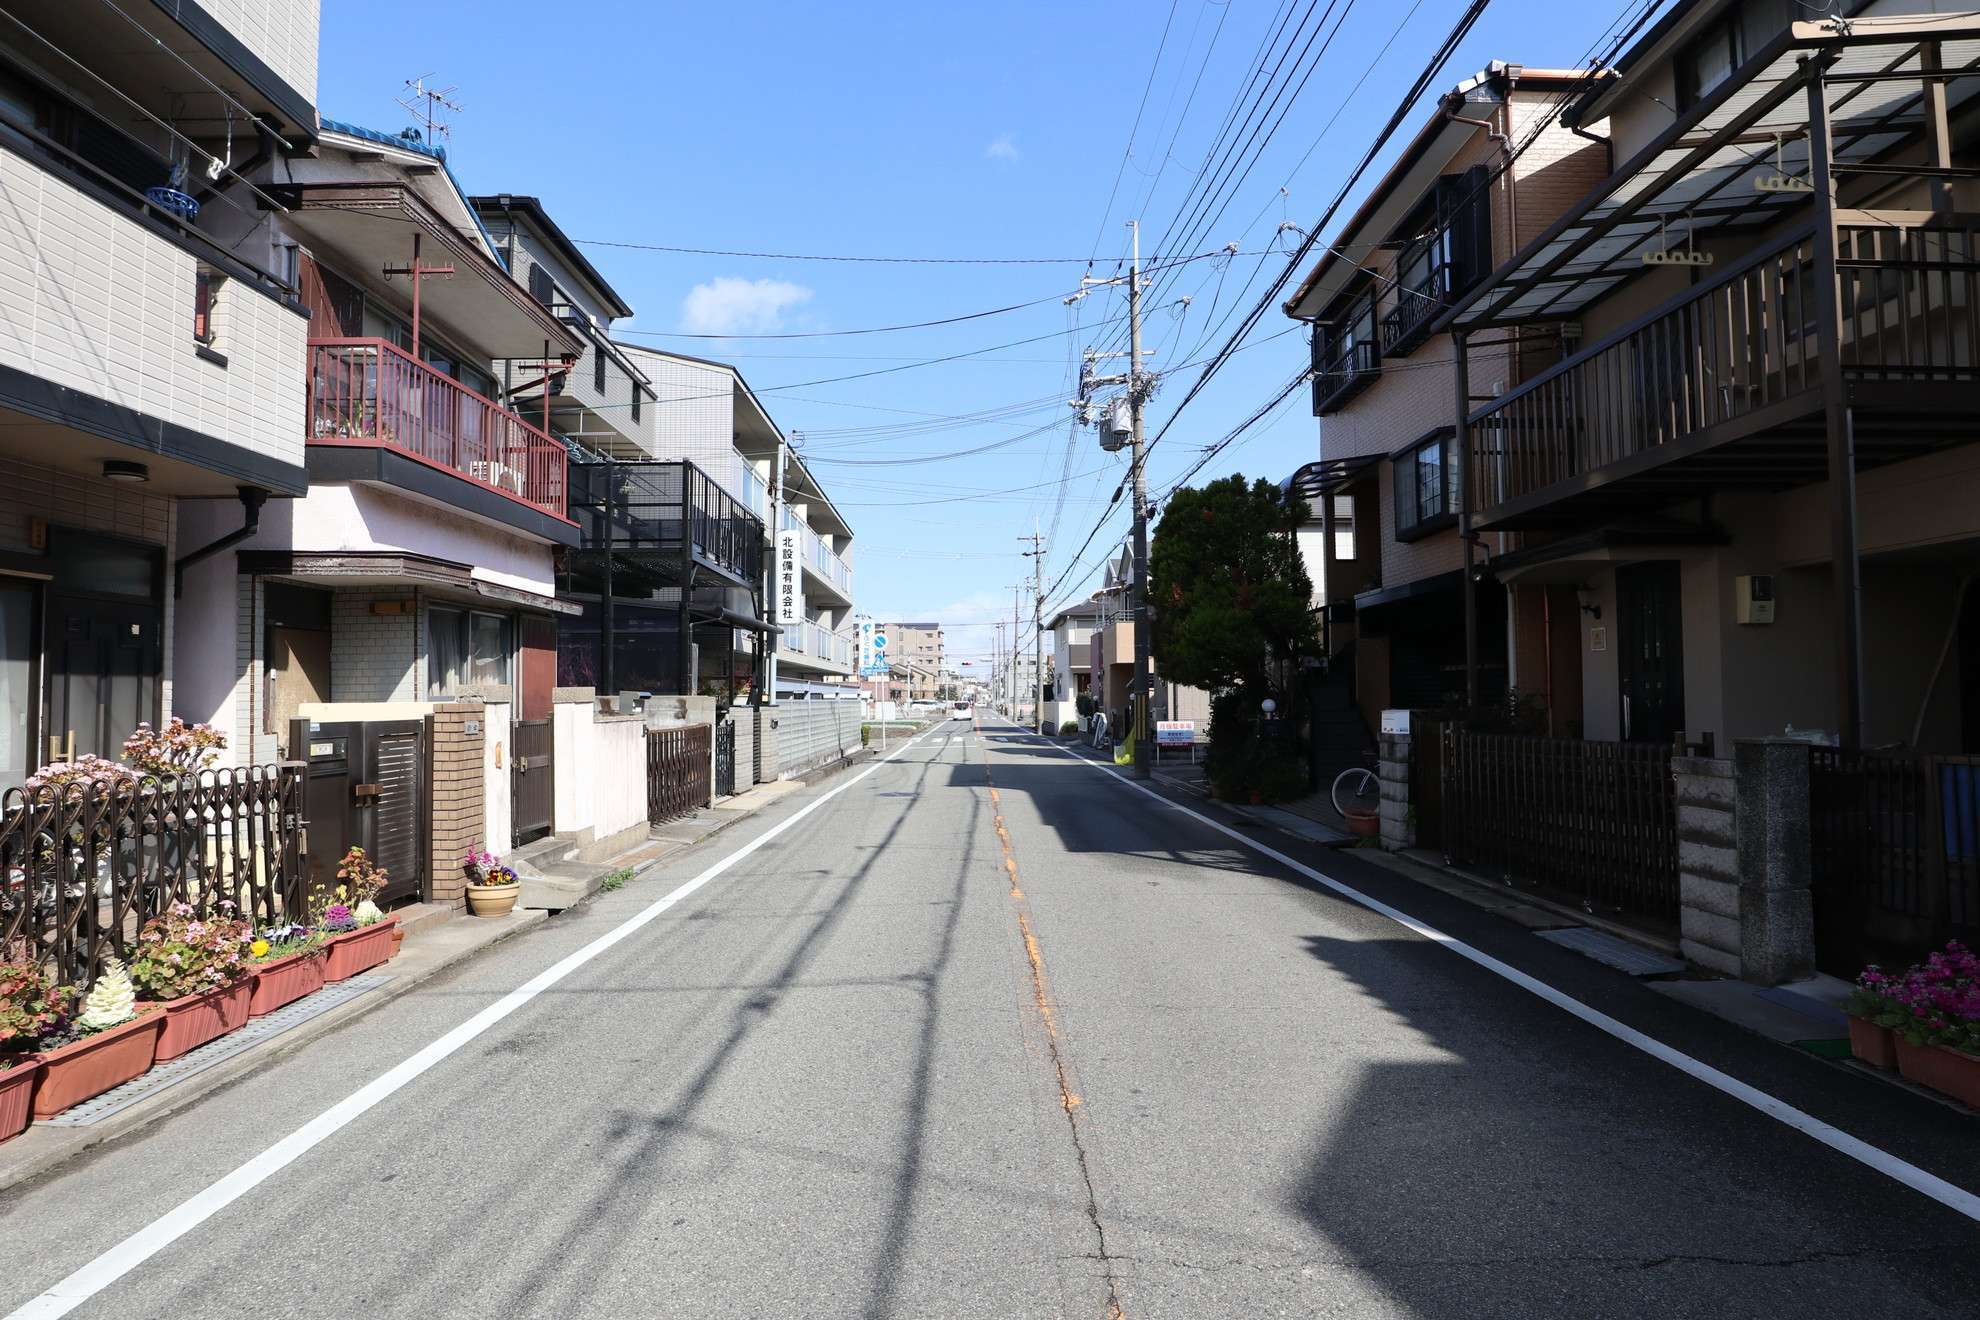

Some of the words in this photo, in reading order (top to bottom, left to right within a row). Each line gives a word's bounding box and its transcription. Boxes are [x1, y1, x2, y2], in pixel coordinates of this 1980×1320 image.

[782, 536, 793, 619] 北設備有限会社
